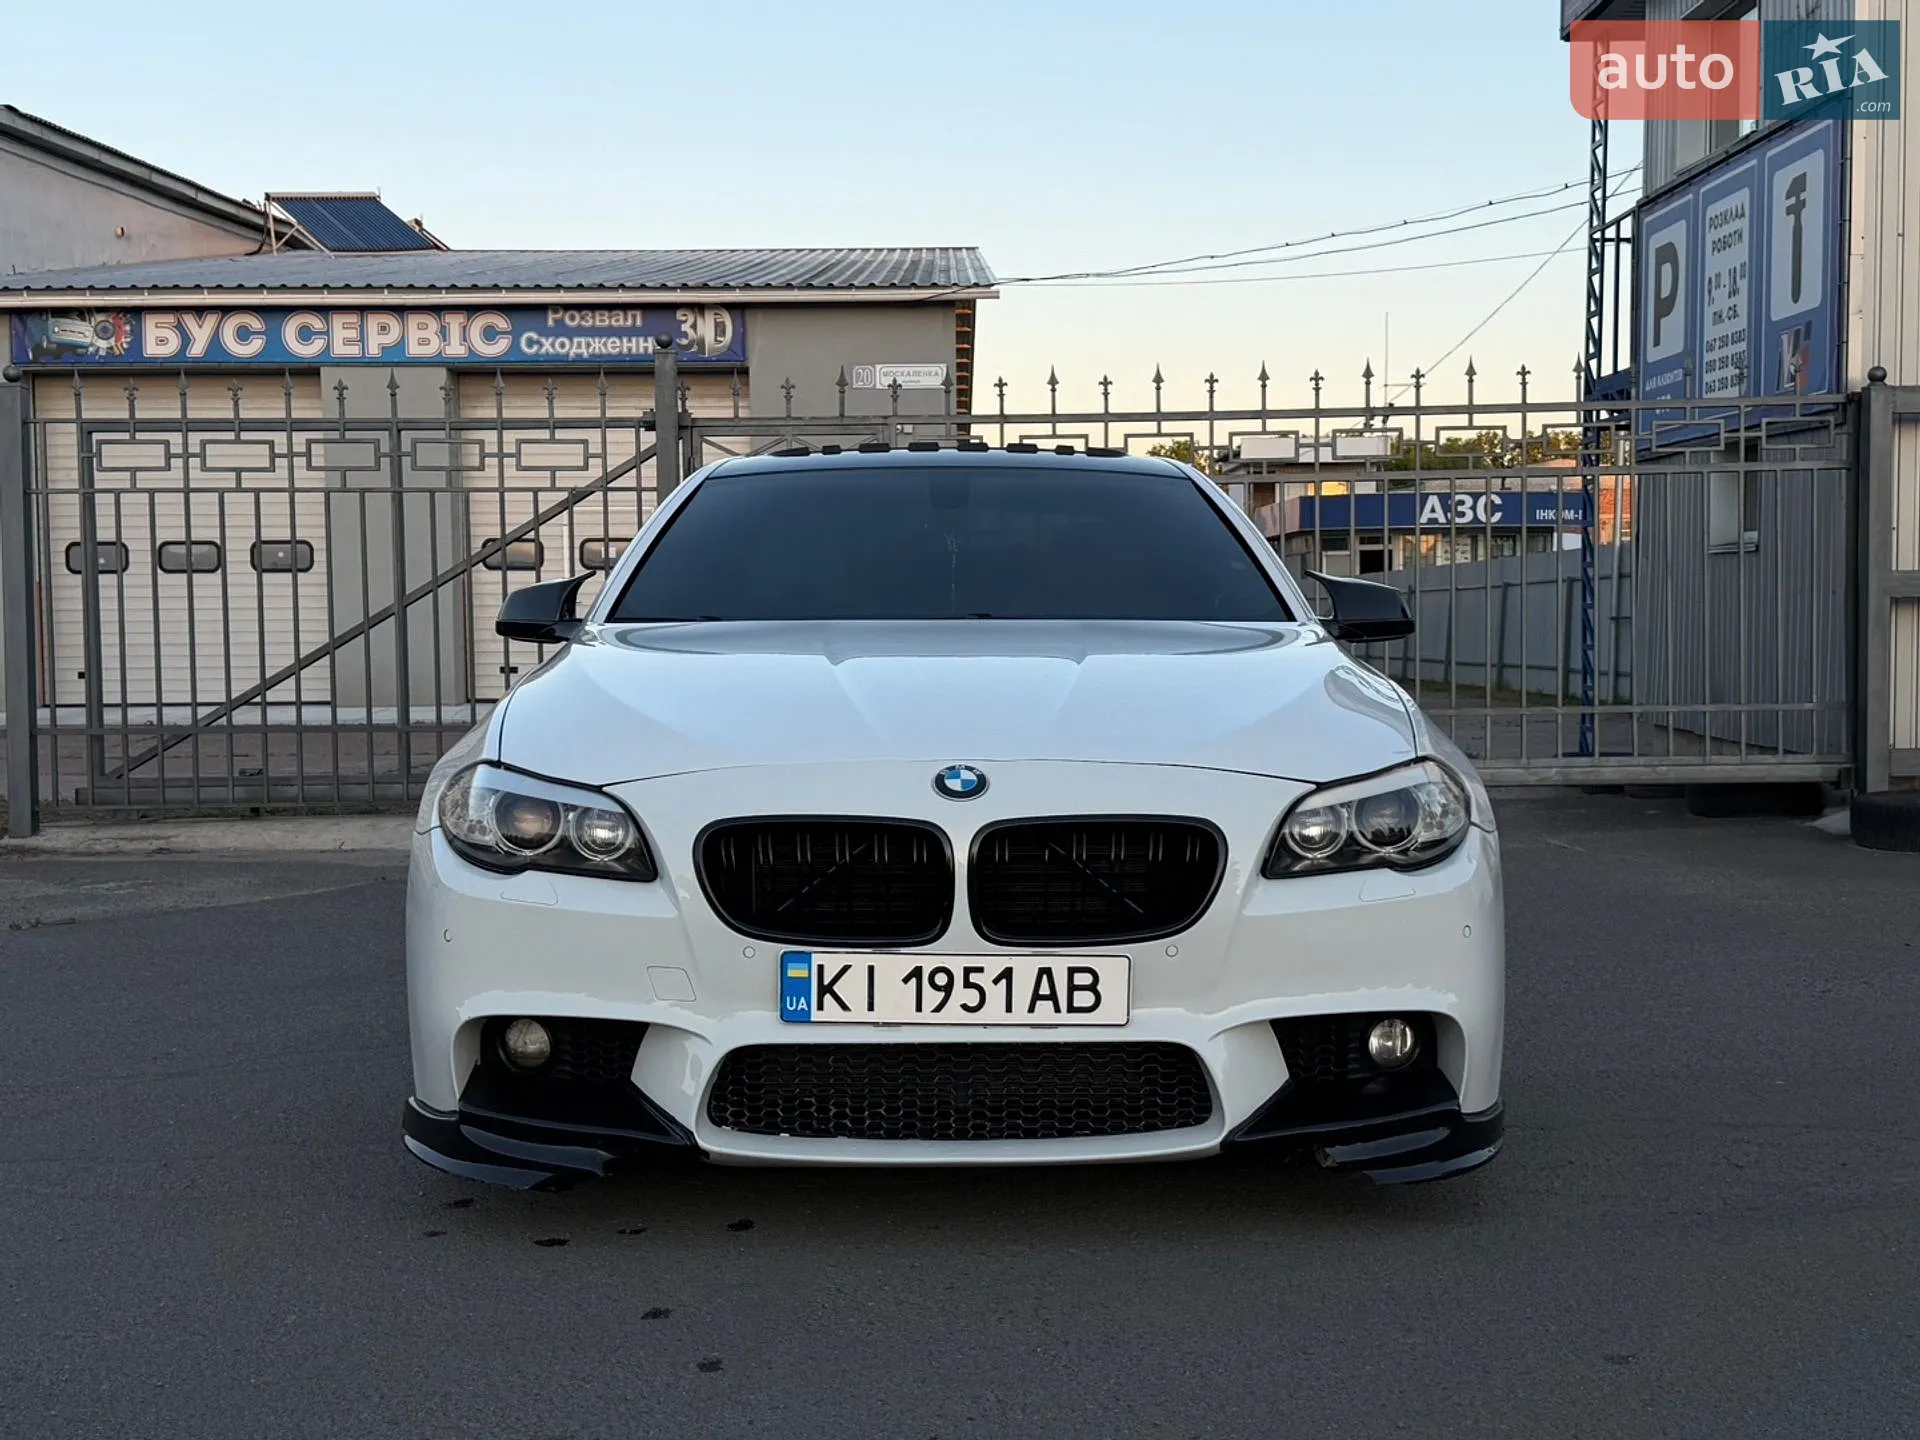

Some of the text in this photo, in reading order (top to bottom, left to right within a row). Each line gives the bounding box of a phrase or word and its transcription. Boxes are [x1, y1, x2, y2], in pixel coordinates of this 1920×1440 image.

[1708, 201, 1746, 233] РОЗКЛАД
[1711, 228, 1744, 256] РОБОТИ
[546, 306, 643, 328] Розвал
[676, 305, 733, 358] 3D
[142, 310, 513, 358] БУС СЕРВІС
[856, 368, 872, 386] 20
[1420, 494, 1503, 524] АЗС
[816, 964, 876, 1012] KI
[786, 999, 809, 1011] UA
